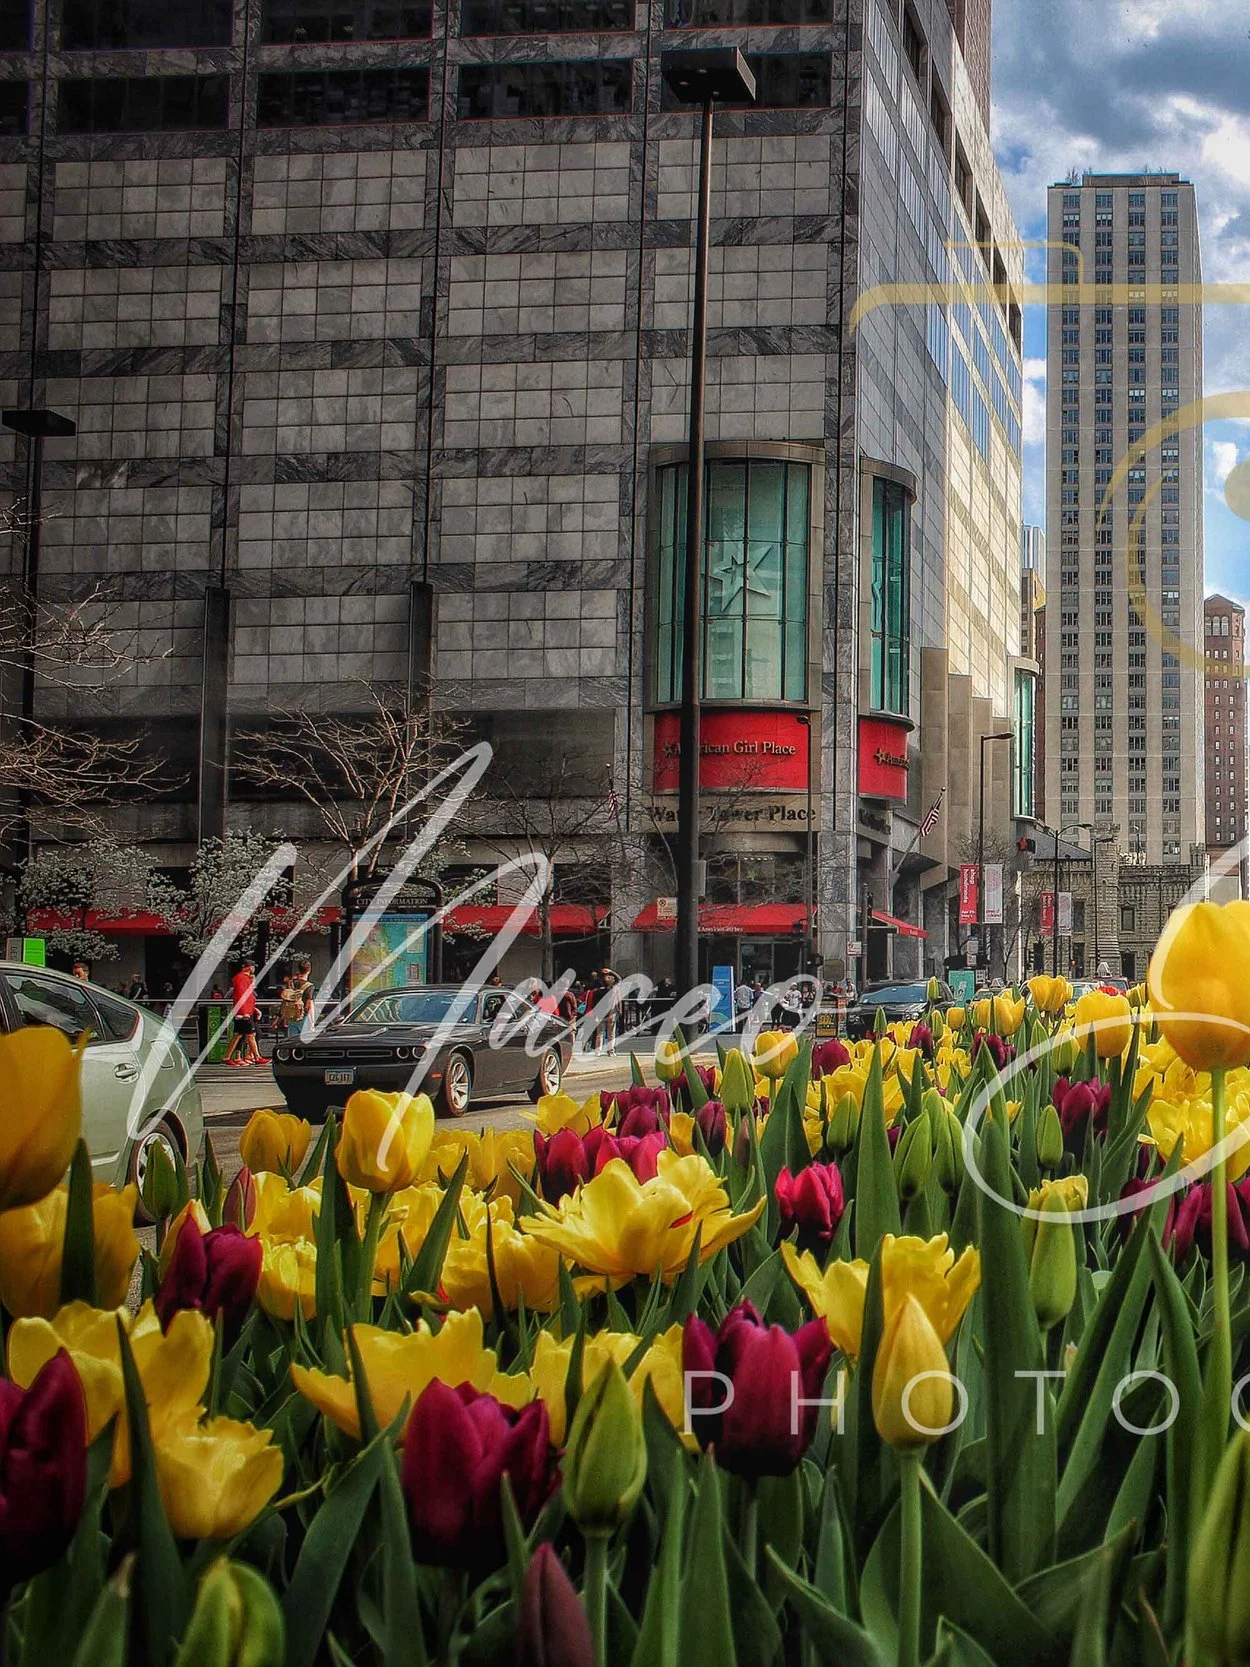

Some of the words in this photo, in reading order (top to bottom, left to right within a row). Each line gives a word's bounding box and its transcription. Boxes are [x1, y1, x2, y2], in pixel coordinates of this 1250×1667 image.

[675, 741, 730, 754] Arican
[733, 740, 758, 754] Girl
[762, 741, 796, 755] Place
[768, 805, 817, 821] Place
